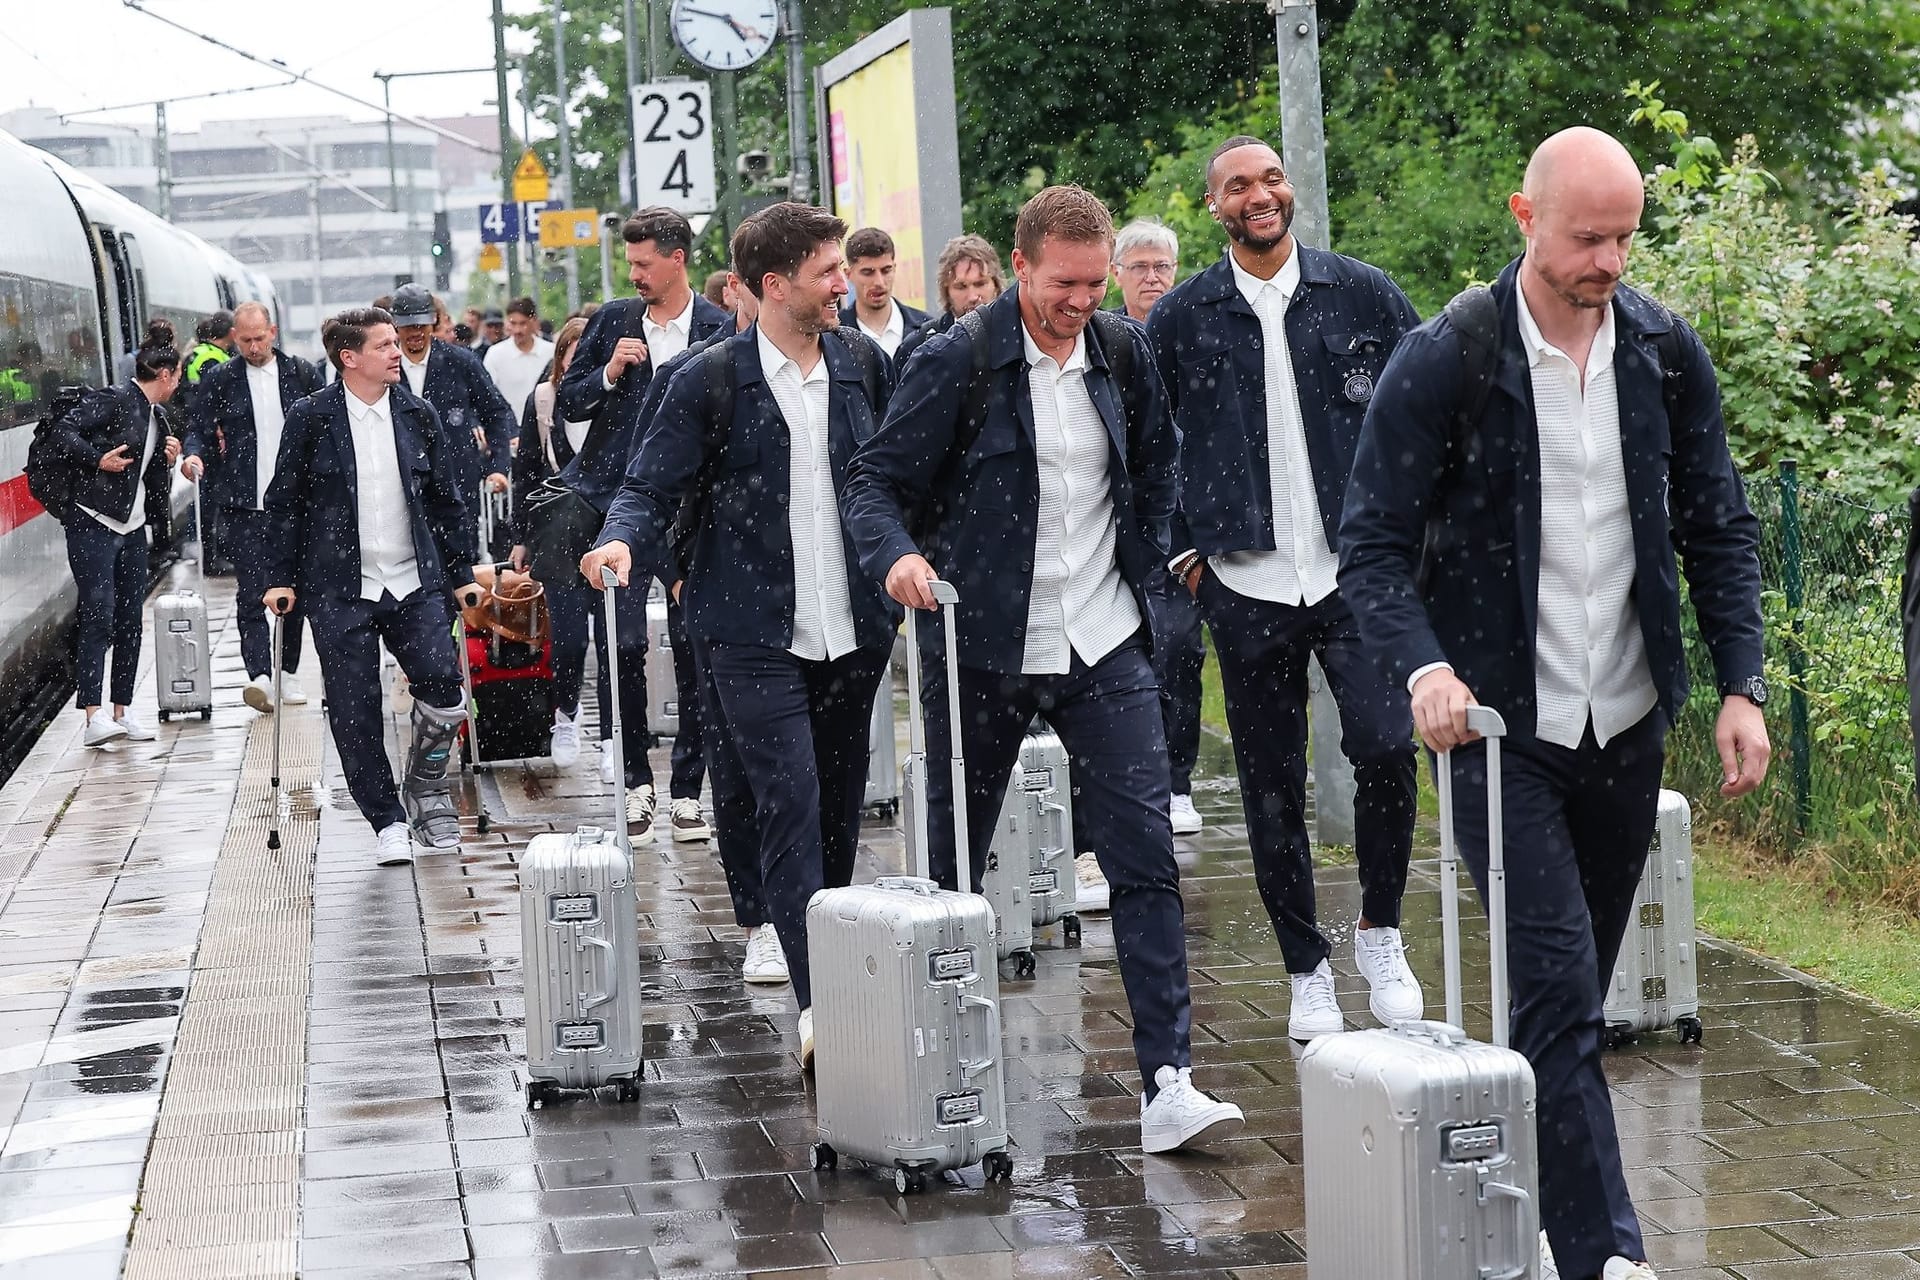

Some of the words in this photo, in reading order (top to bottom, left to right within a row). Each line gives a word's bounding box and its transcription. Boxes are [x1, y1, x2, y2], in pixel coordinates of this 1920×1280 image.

[641, 91, 705, 142] 23
[660, 149, 694, 198] 4
[483, 203, 506, 236] 4
